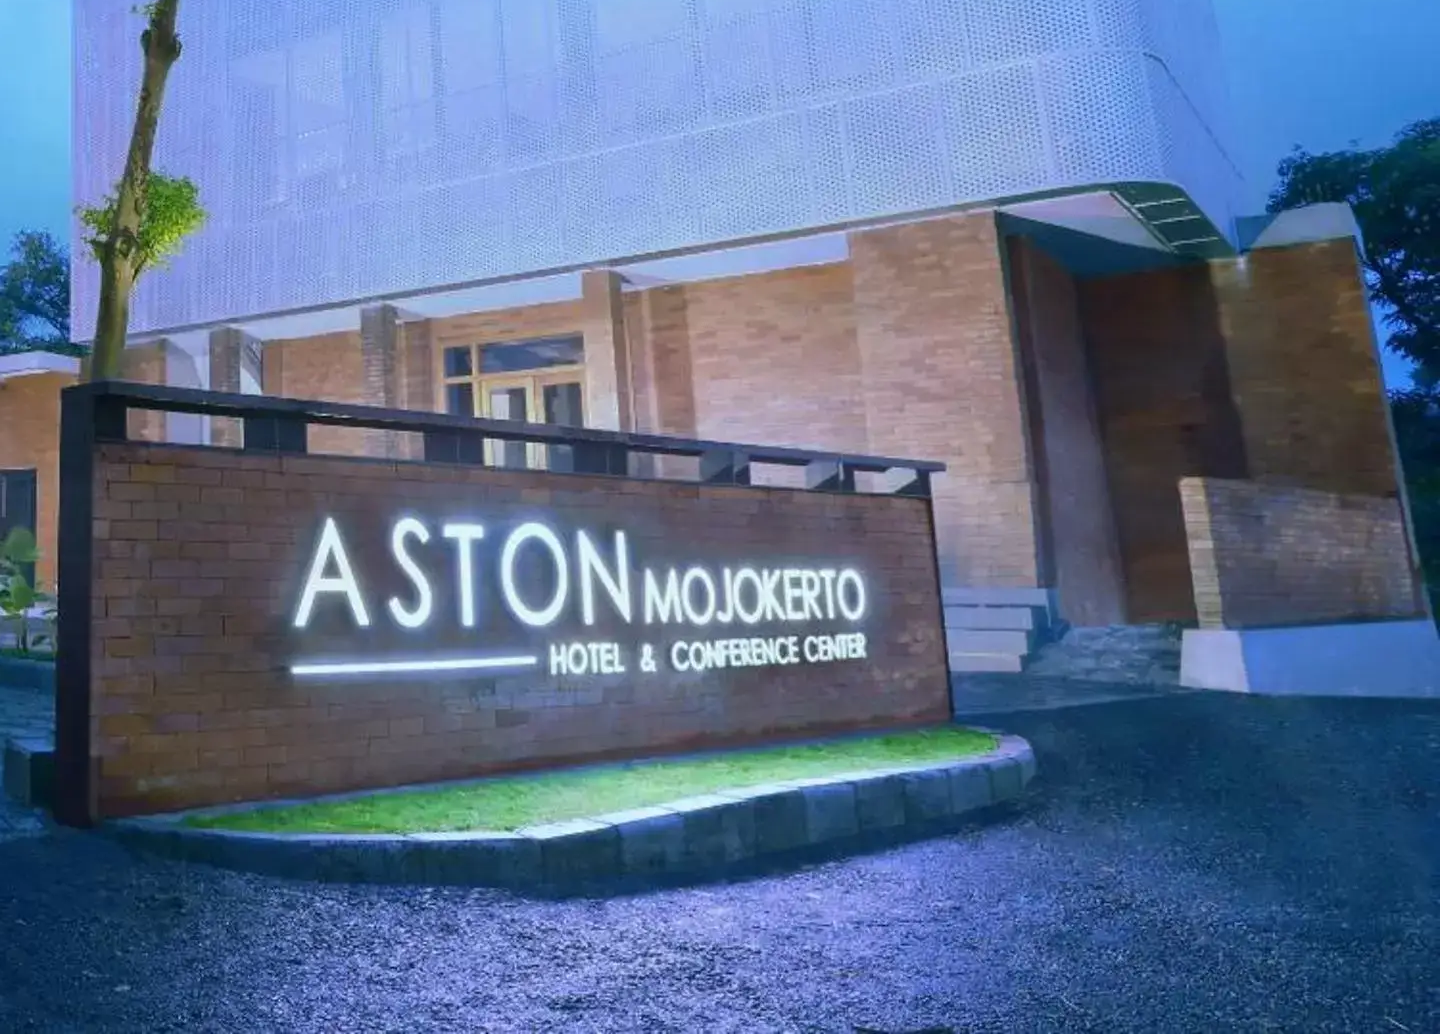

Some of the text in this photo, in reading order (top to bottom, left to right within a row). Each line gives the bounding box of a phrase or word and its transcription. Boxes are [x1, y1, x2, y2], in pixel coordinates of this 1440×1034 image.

[294, 517, 866, 628] ASTON MOJOKERTO
[550, 632, 867, 675] HOTEL & CONFERENCE CENTER
